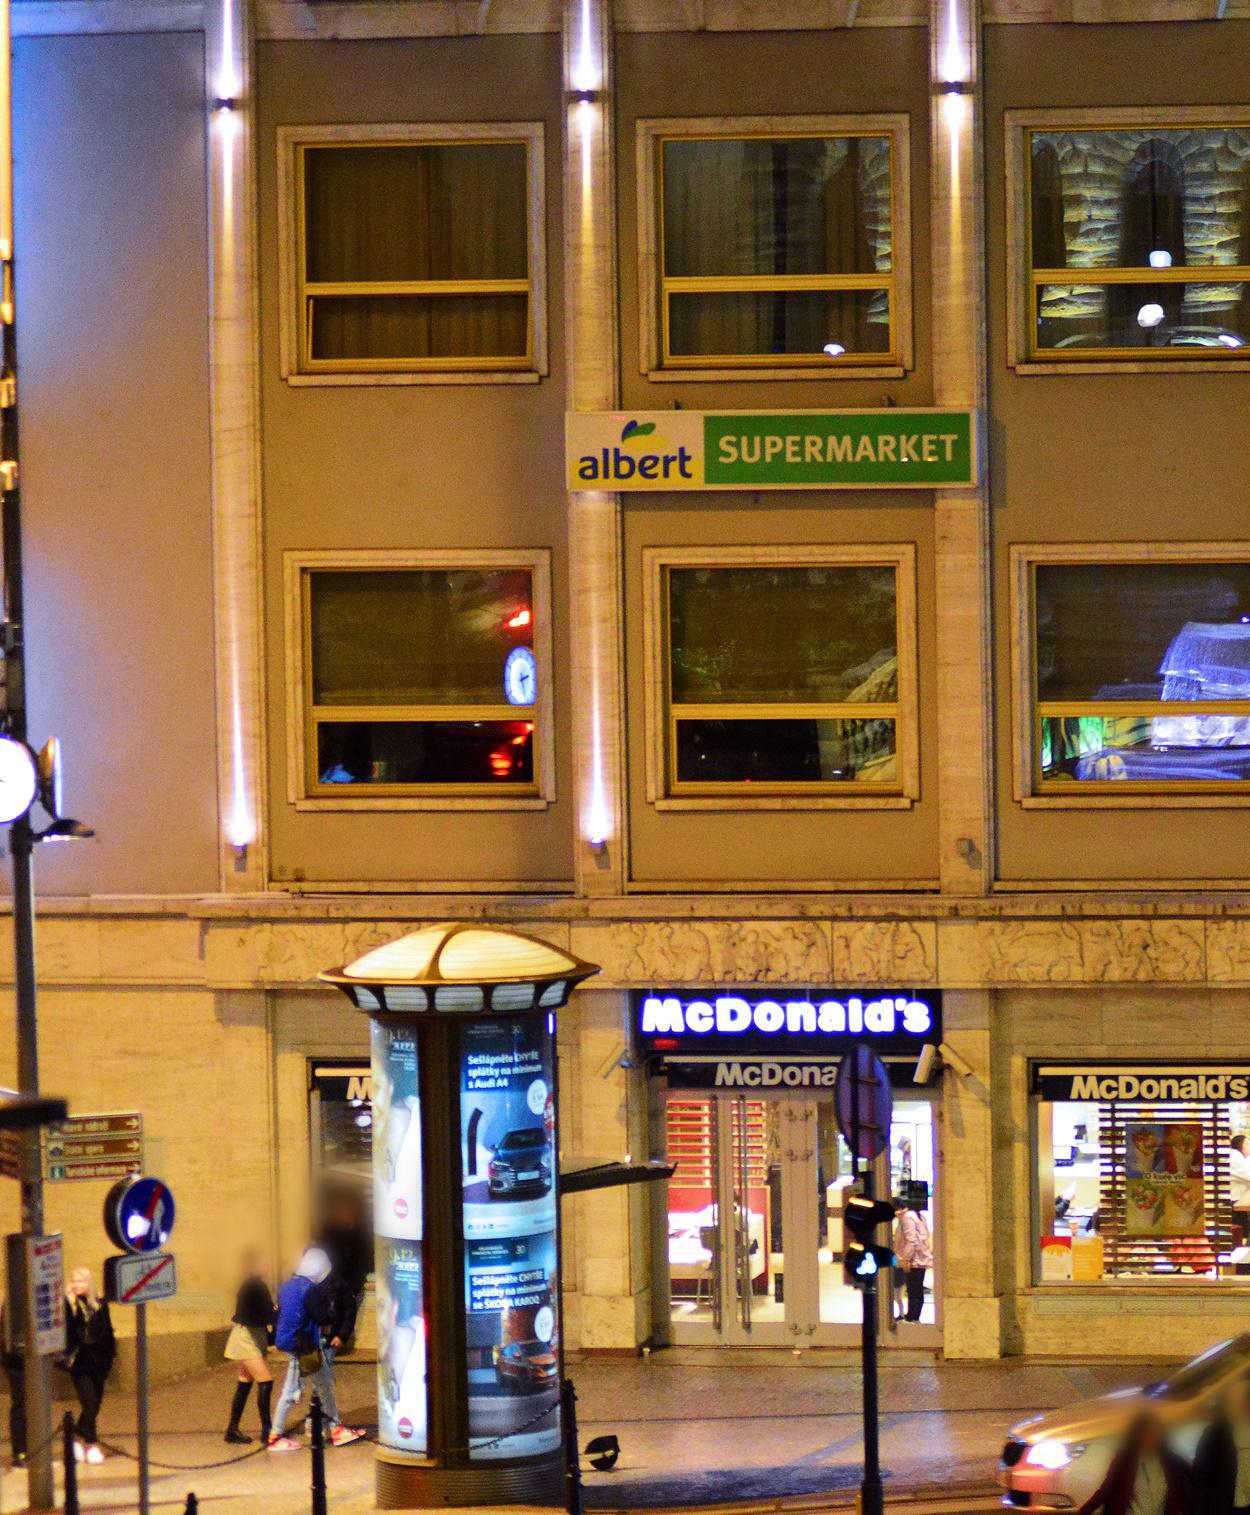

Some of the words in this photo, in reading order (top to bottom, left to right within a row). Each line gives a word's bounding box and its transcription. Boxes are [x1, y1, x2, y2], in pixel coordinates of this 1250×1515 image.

[578, 446, 693, 480] albert
[718, 434, 958, 464] SUPERMARKET
[641, 997, 931, 1033] McDonald's
[715, 1062, 839, 1086] McDona
[1070, 1075, 1250, 1100] McDonald's
